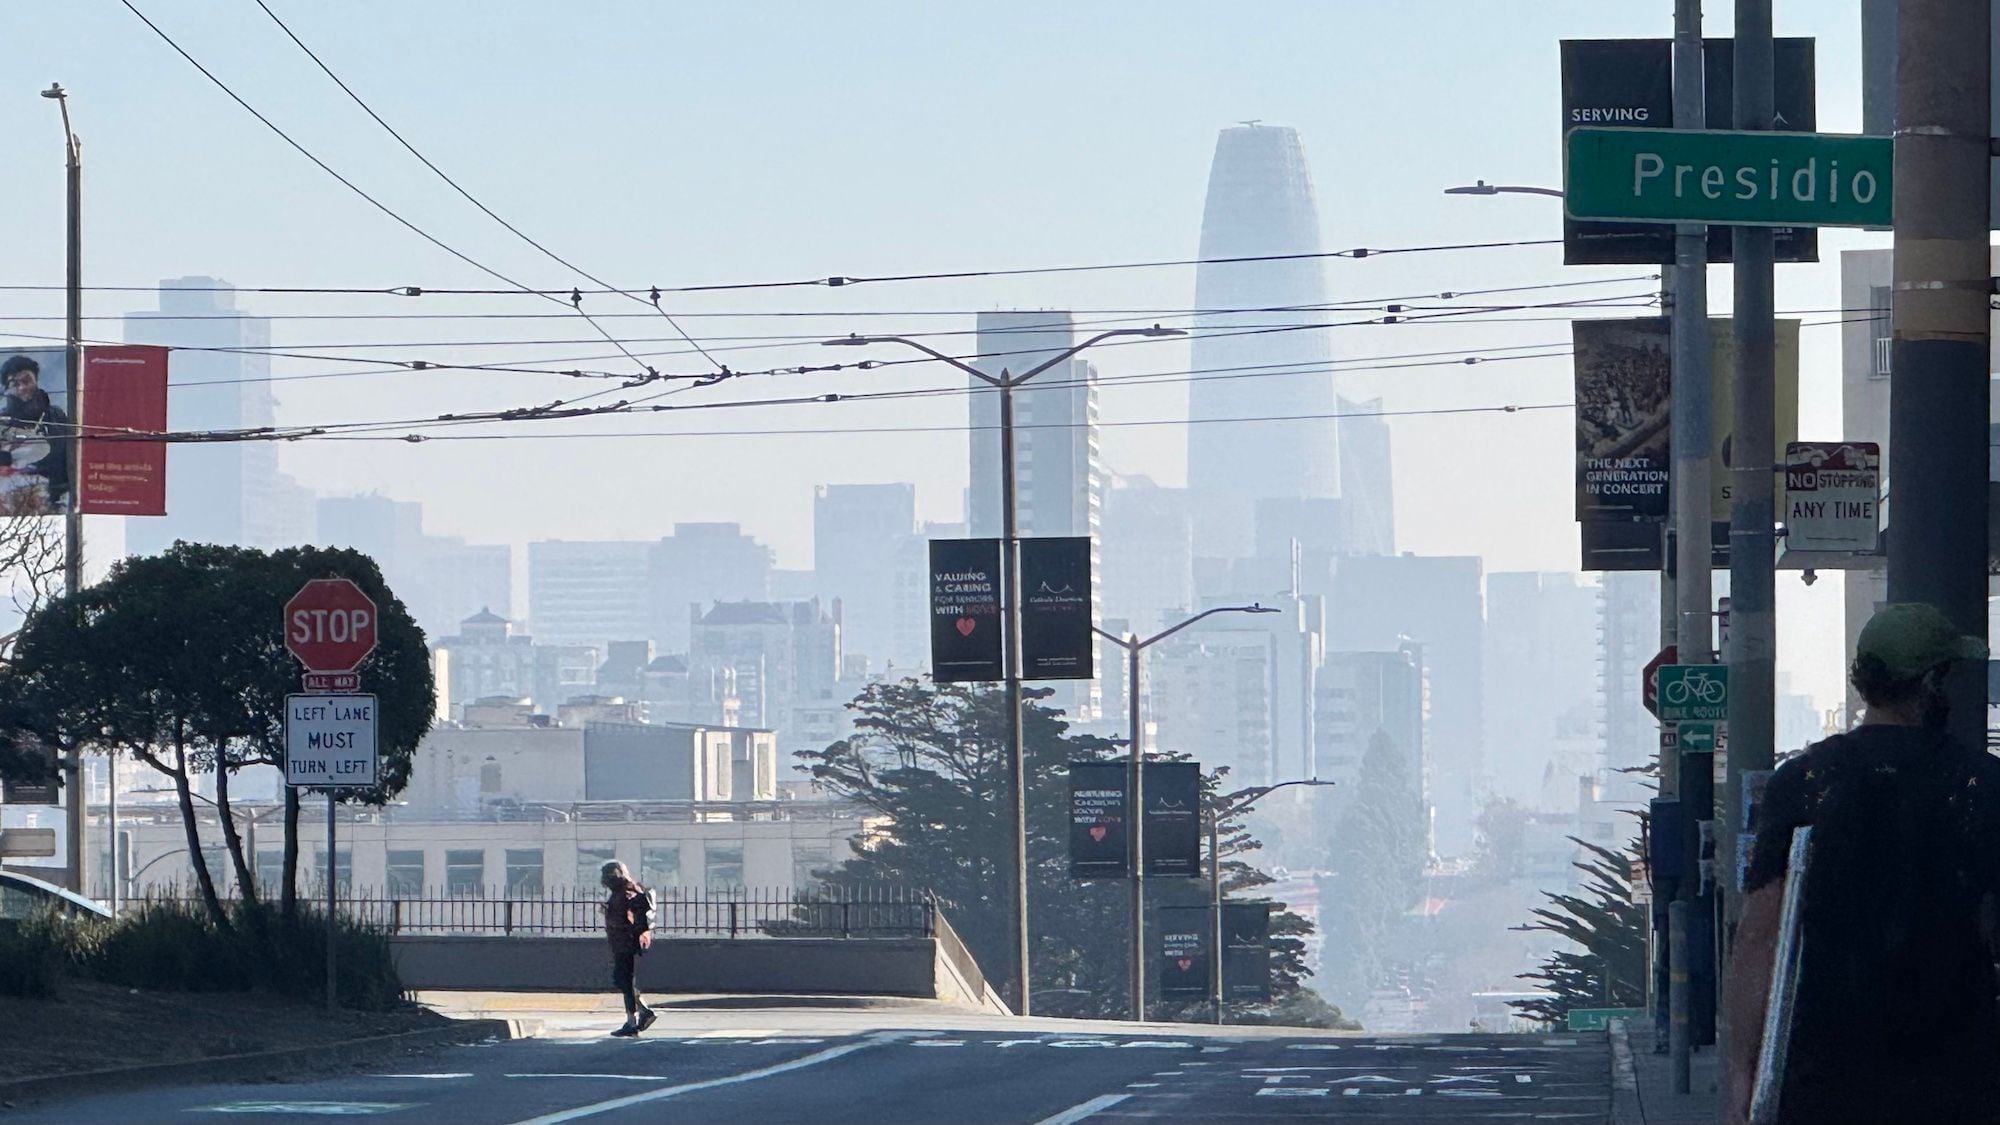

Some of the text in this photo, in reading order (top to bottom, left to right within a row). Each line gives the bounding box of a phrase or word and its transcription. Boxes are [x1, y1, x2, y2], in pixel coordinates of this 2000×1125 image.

[1571, 107, 1649, 122] SERVING
[1633, 152, 1877, 204] Presidio
[1587, 457, 1649, 469] THE NEXT
[1586, 470, 1669, 482] GENERATION
[1788, 473, 1875, 489] NO STOPPING
[1586, 483, 1664, 495] IN CONCERT
[1793, 502, 1872, 519] ANY TIME
[935, 572, 986, 582] VALUING
[945, 584, 992, 593] CARING
[935, 606, 963, 615] WITH
[292, 609, 370, 644] STOP
[307, 676, 355, 689] ALL WAY
[294, 706, 371, 721] LEFT LANE
[308, 731, 355, 749] MUST
[291, 759, 368, 774] TURN LEFT
[1240, 1074, 1532, 1084] TAXI
[1255, 1087, 1503, 1097] BUS
